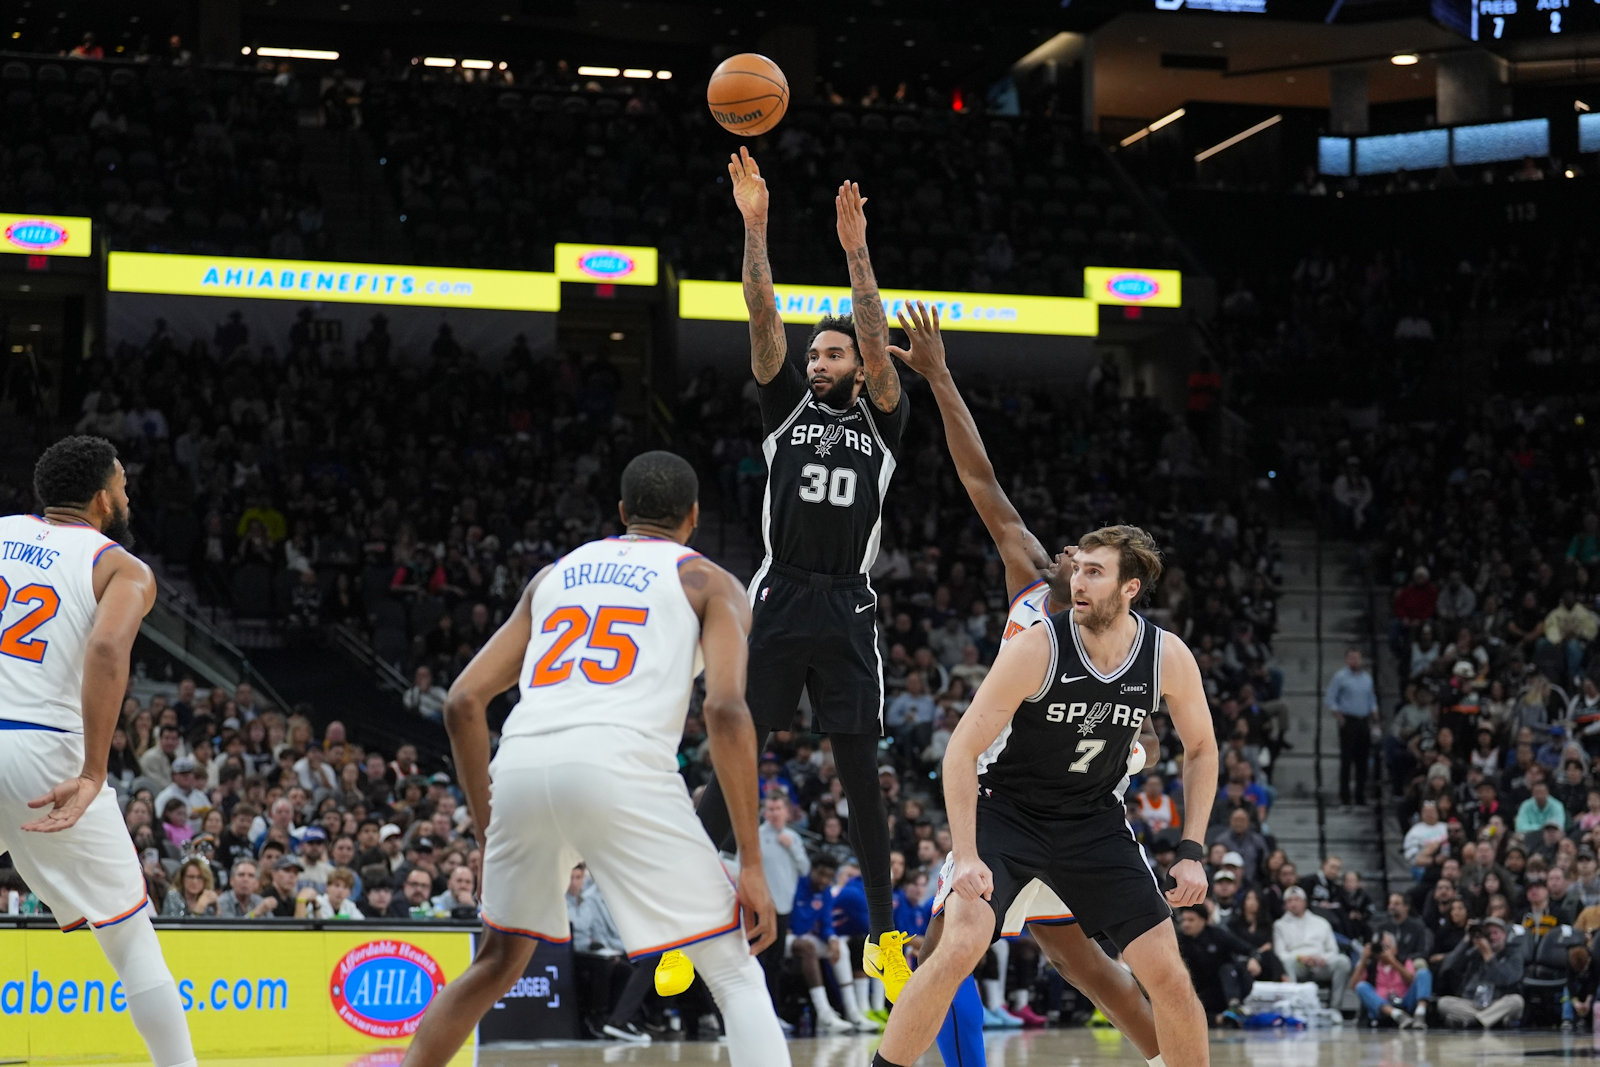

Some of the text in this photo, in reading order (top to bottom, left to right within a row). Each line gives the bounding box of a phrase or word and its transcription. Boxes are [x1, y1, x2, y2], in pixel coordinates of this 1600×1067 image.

[1493, 16, 1505, 39] 7
[713, 109, 763, 124] Wilson
[790, 424, 872, 457] SPURS
[799, 463, 858, 508] 30
[2, 541, 60, 570] TOWNS
[563, 562, 658, 593] BRIDGES
[0, 575, 61, 664] 2
[529, 605, 649, 688] 25
[1046, 702, 1147, 736] SPURS
[1067, 739, 1107, 773] 7
[352, 968, 423, 1006] AHIA
